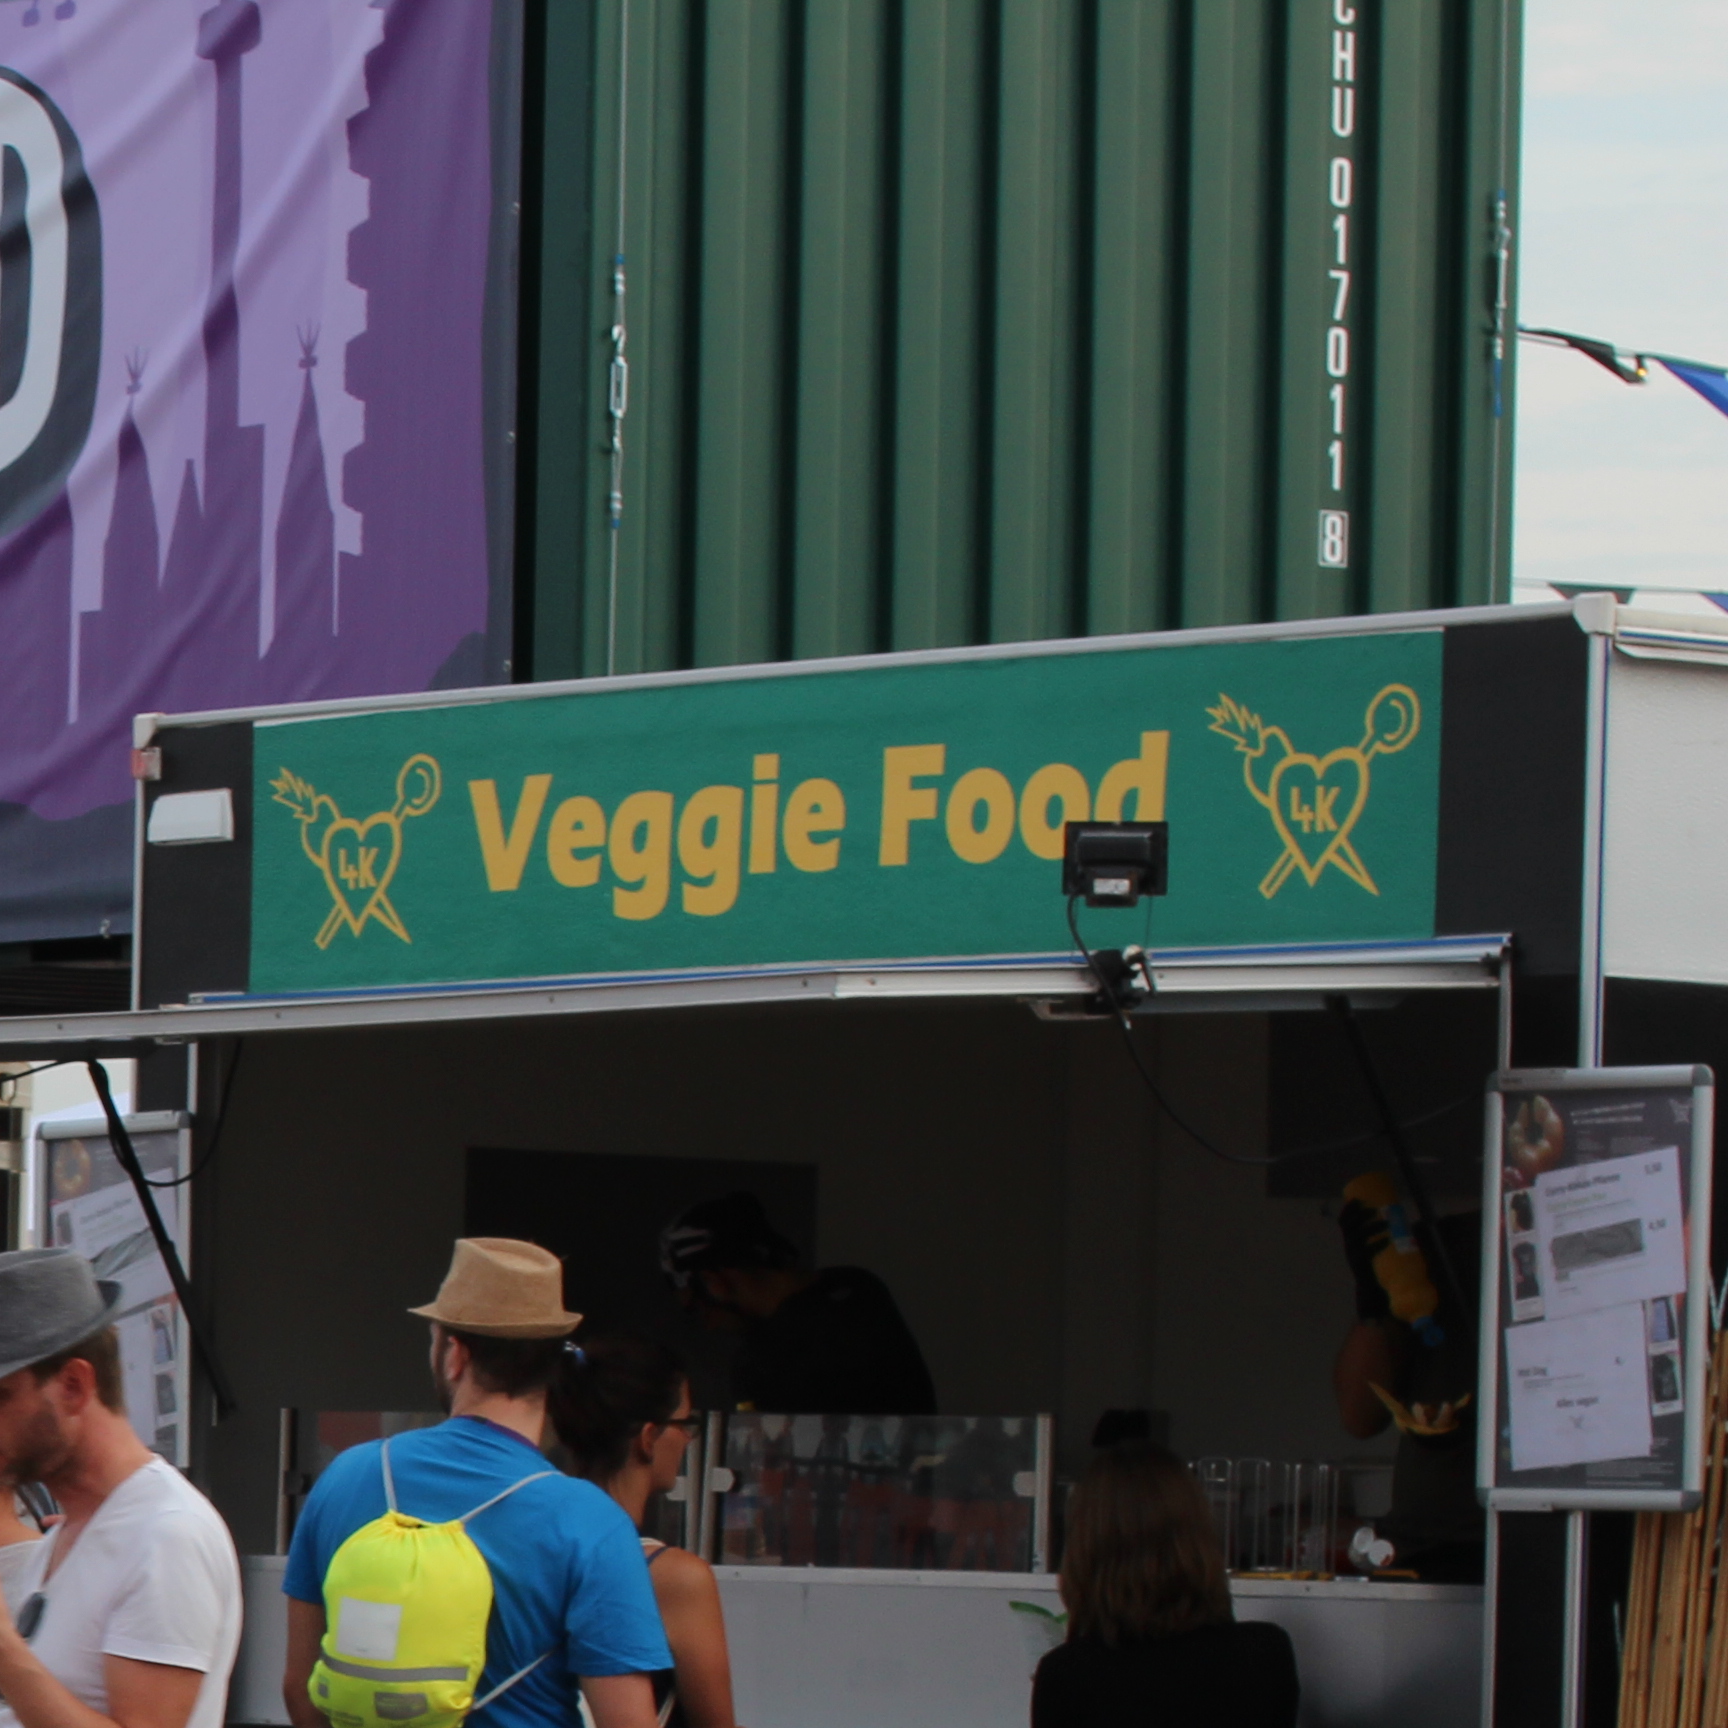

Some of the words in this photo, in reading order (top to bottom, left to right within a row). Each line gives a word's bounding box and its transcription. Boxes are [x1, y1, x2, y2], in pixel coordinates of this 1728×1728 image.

[1326, 156, 1353, 492] 017011
[1323, 516, 1343, 563] 8
[468, 751, 847, 922] Veggie
[878, 729, 1170, 867] Food
[1289, 785, 1341, 833] 4K
[338, 846, 379, 891] 4K
